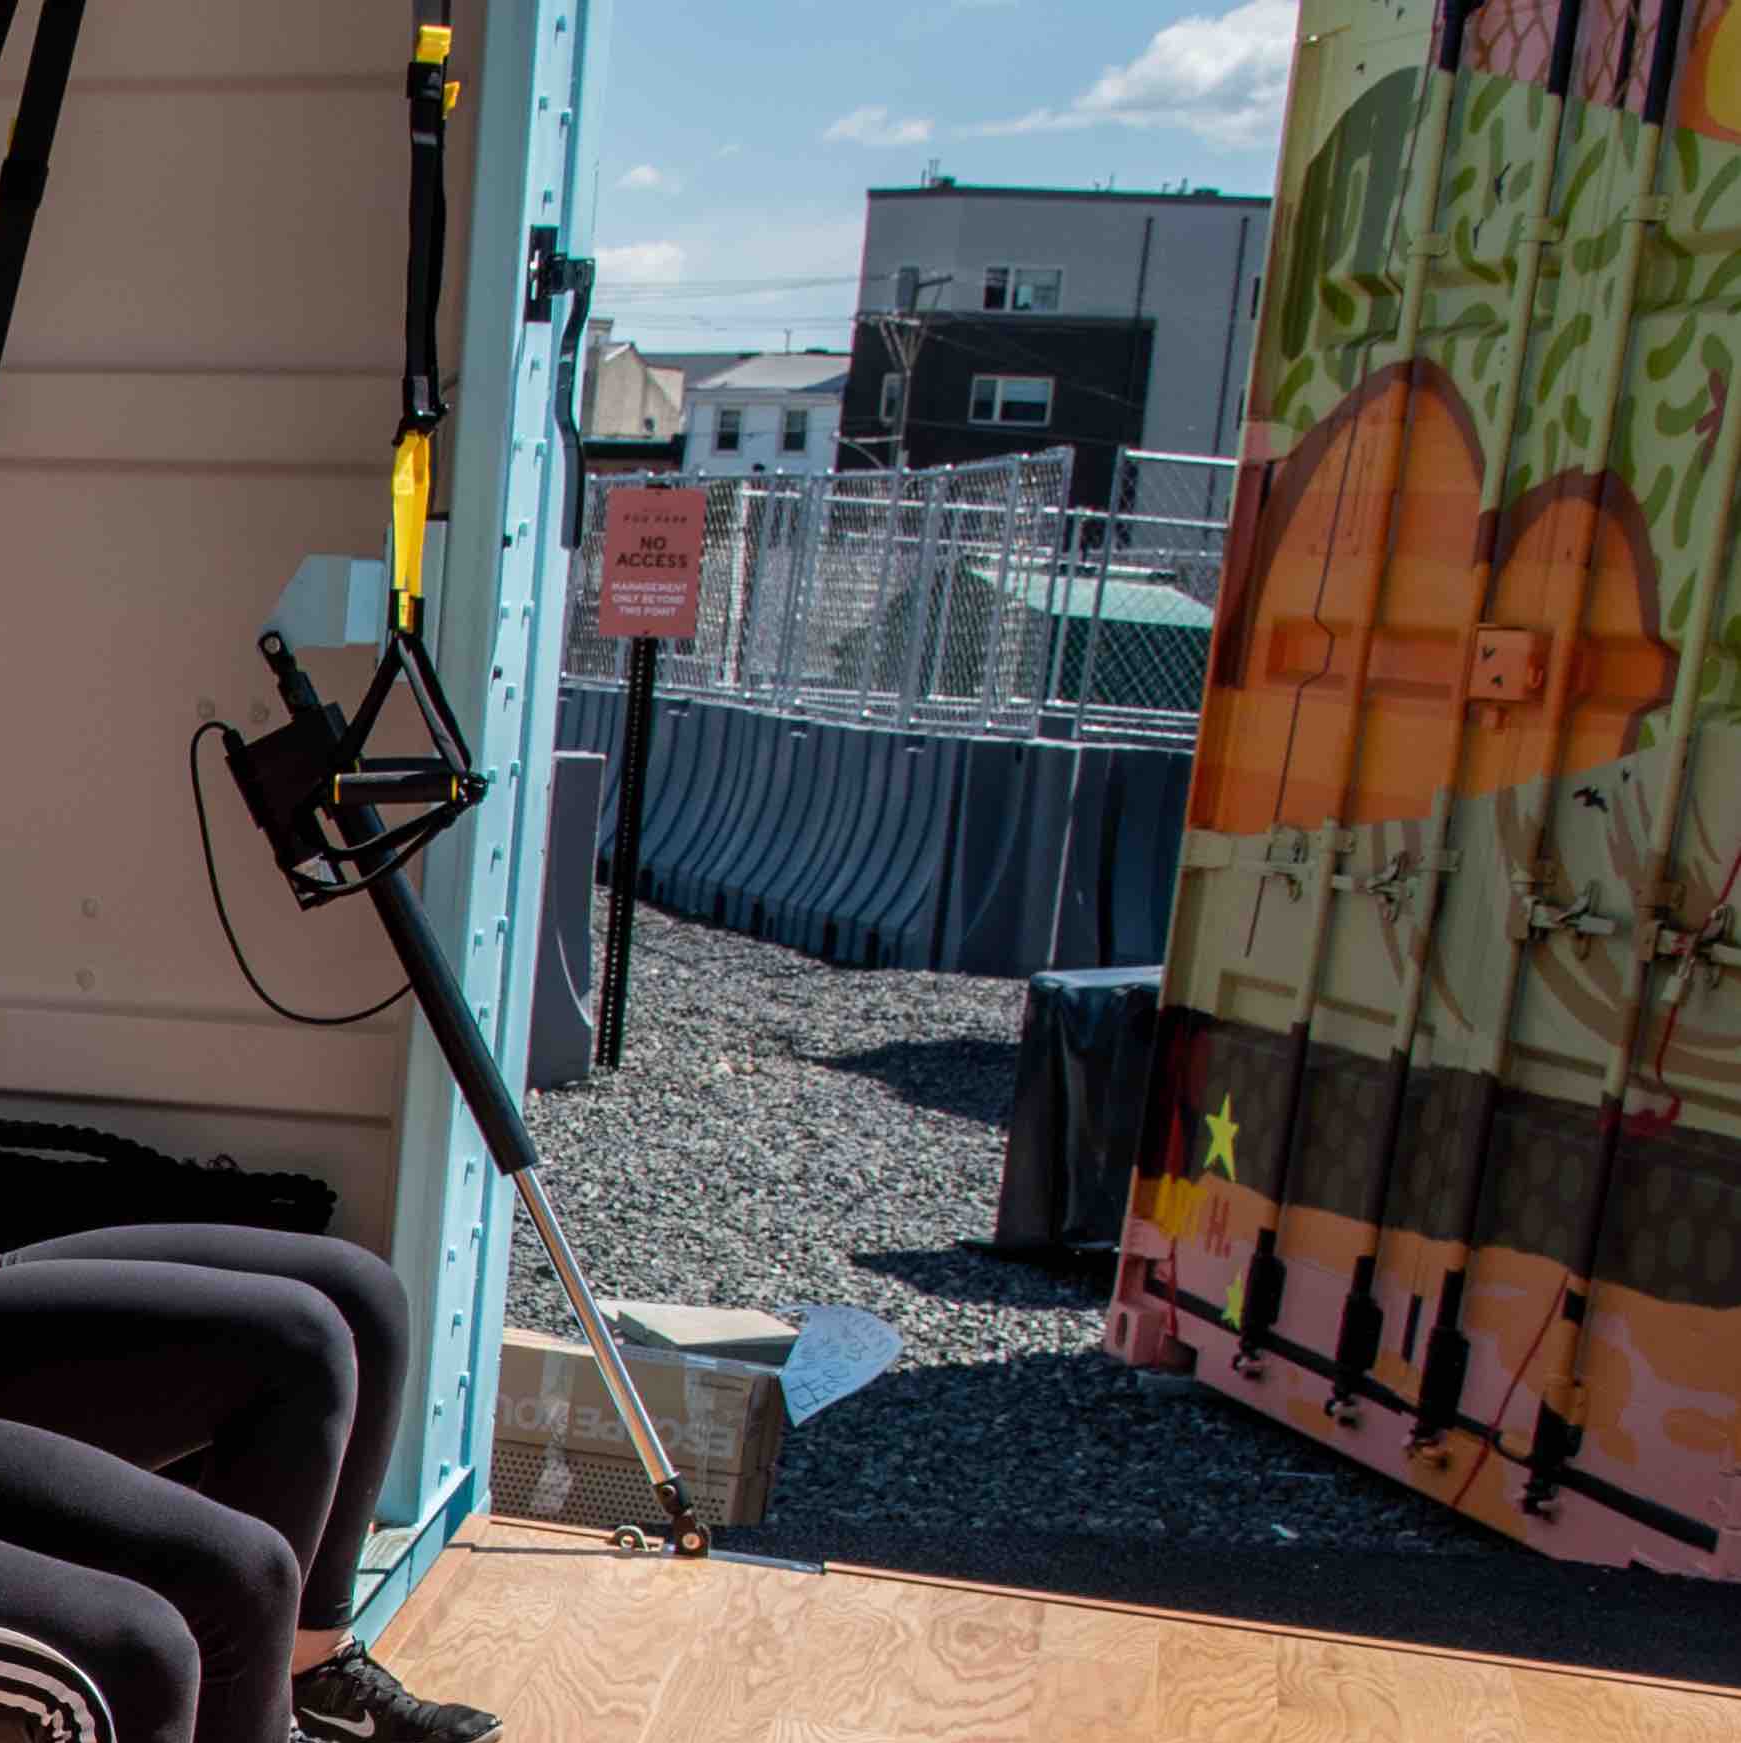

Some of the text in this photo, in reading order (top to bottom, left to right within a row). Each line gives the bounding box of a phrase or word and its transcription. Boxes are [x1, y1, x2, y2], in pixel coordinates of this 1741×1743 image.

[639, 535, 667, 551] NO
[615, 553, 689, 569] ACCESS
[611, 583, 689, 593] MANAGEMENT
